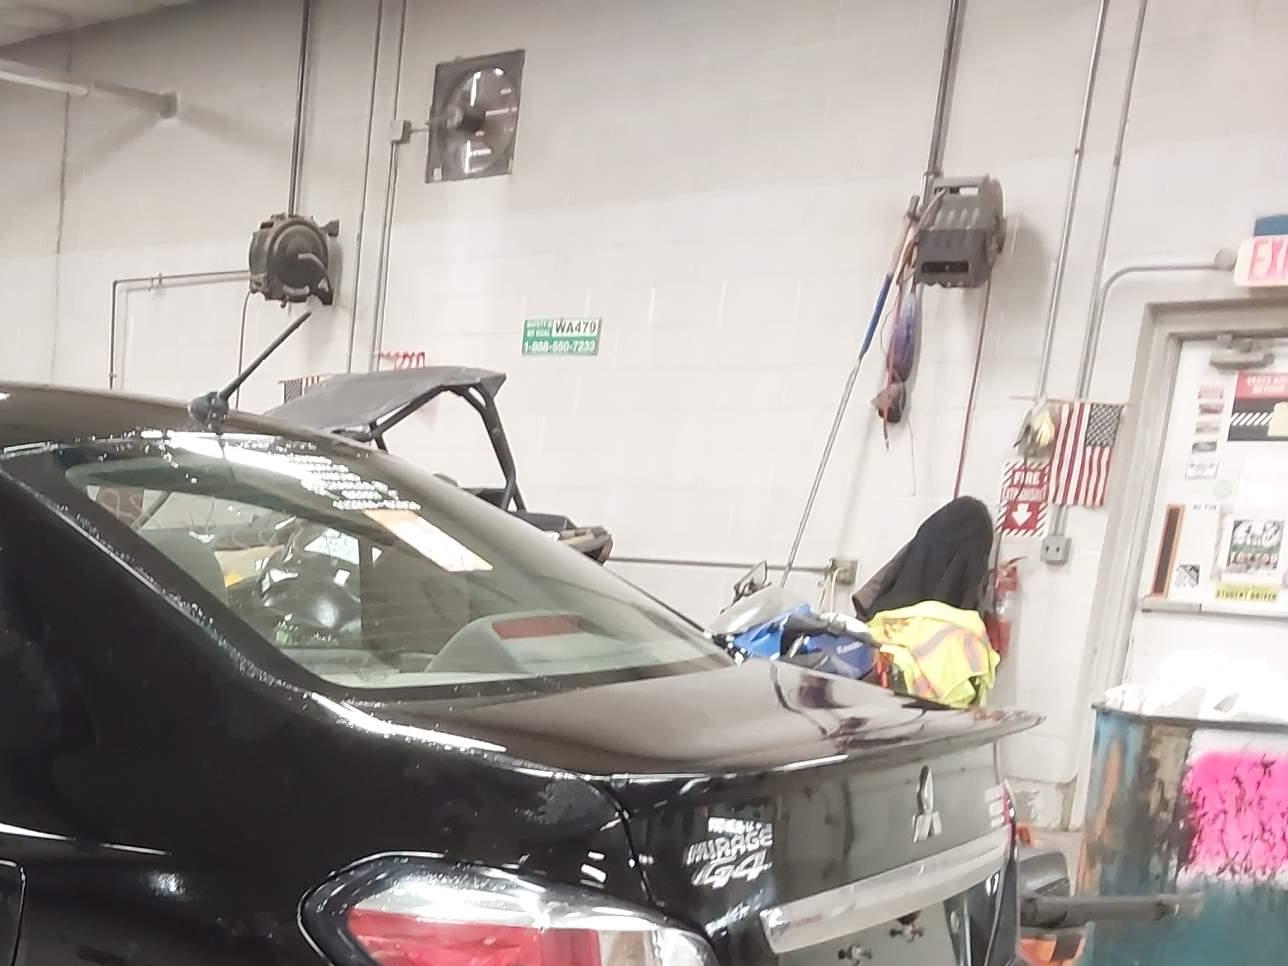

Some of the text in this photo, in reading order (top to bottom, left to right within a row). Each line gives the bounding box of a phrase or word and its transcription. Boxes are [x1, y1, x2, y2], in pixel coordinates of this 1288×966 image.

[1013, 470, 1042, 486] FIRE
[683, 830, 774, 866] MIRAGE
[691, 847, 773, 890] G4
